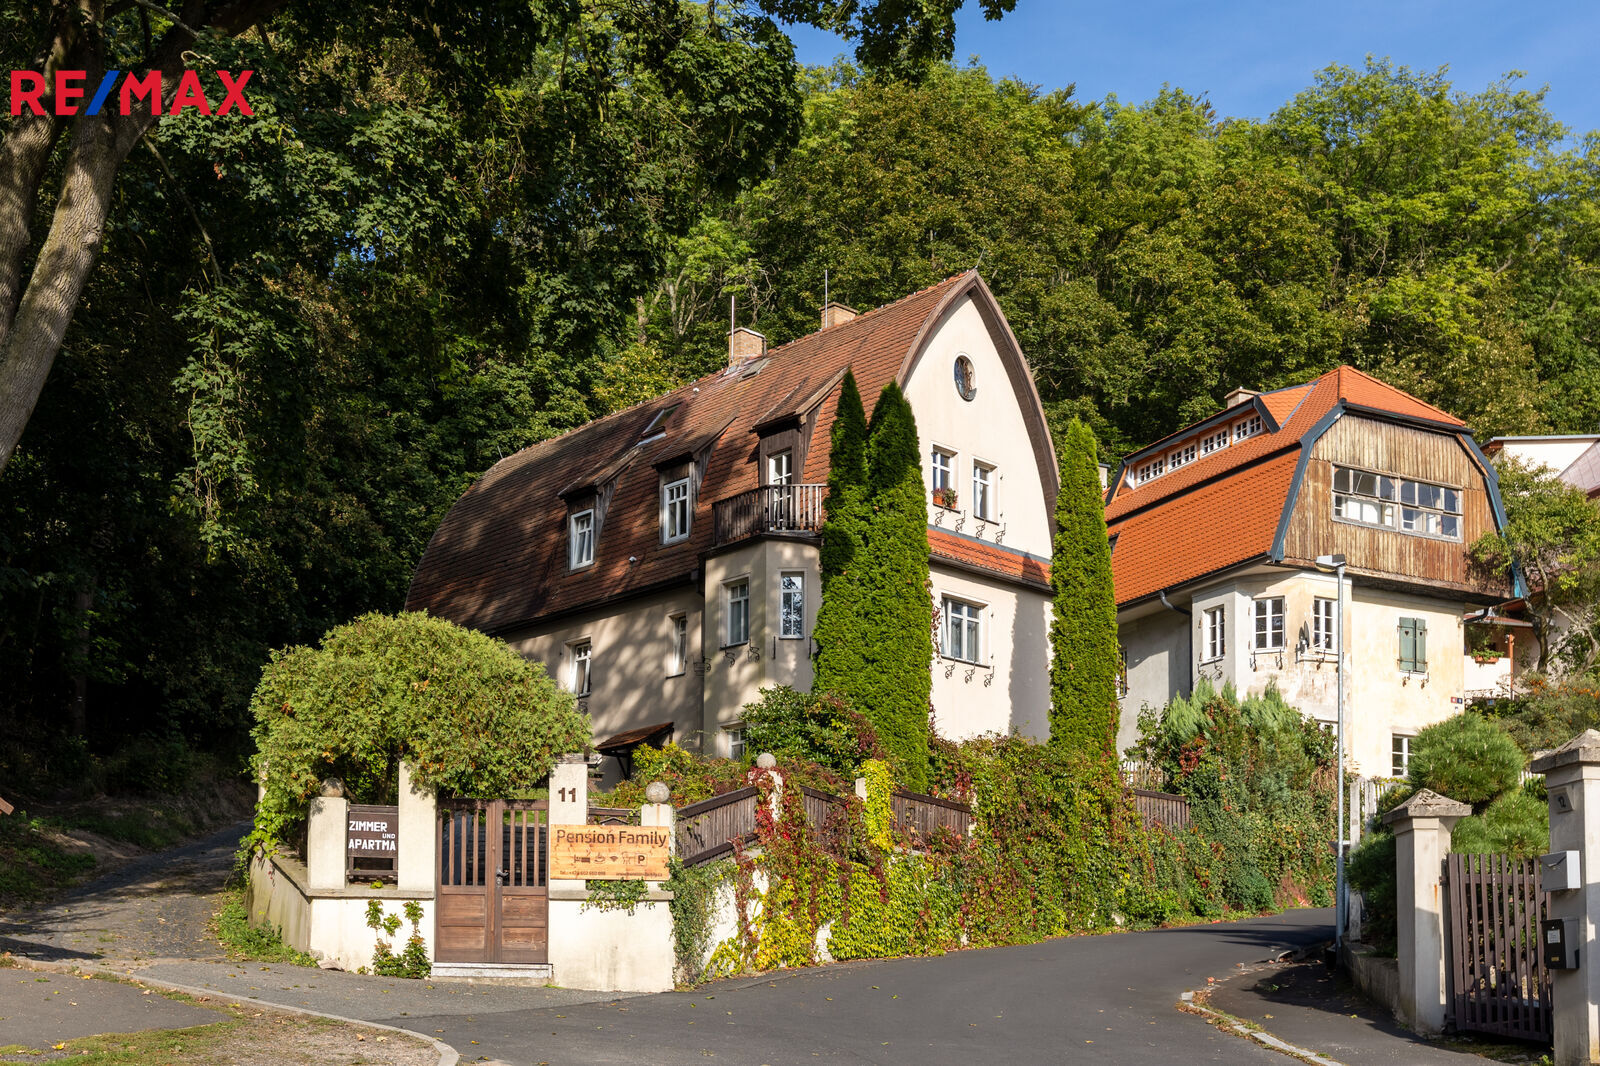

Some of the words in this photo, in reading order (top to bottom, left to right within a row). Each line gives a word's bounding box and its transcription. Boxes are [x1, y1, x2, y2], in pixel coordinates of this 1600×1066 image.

[558, 787, 576, 802] 11
[349, 821, 388, 832] ZIMMER
[348, 838, 396, 851] APARTMA
[556, 829, 615, 844] Pension
[619, 830, 667, 848] Family
[637, 855, 646, 864] P
